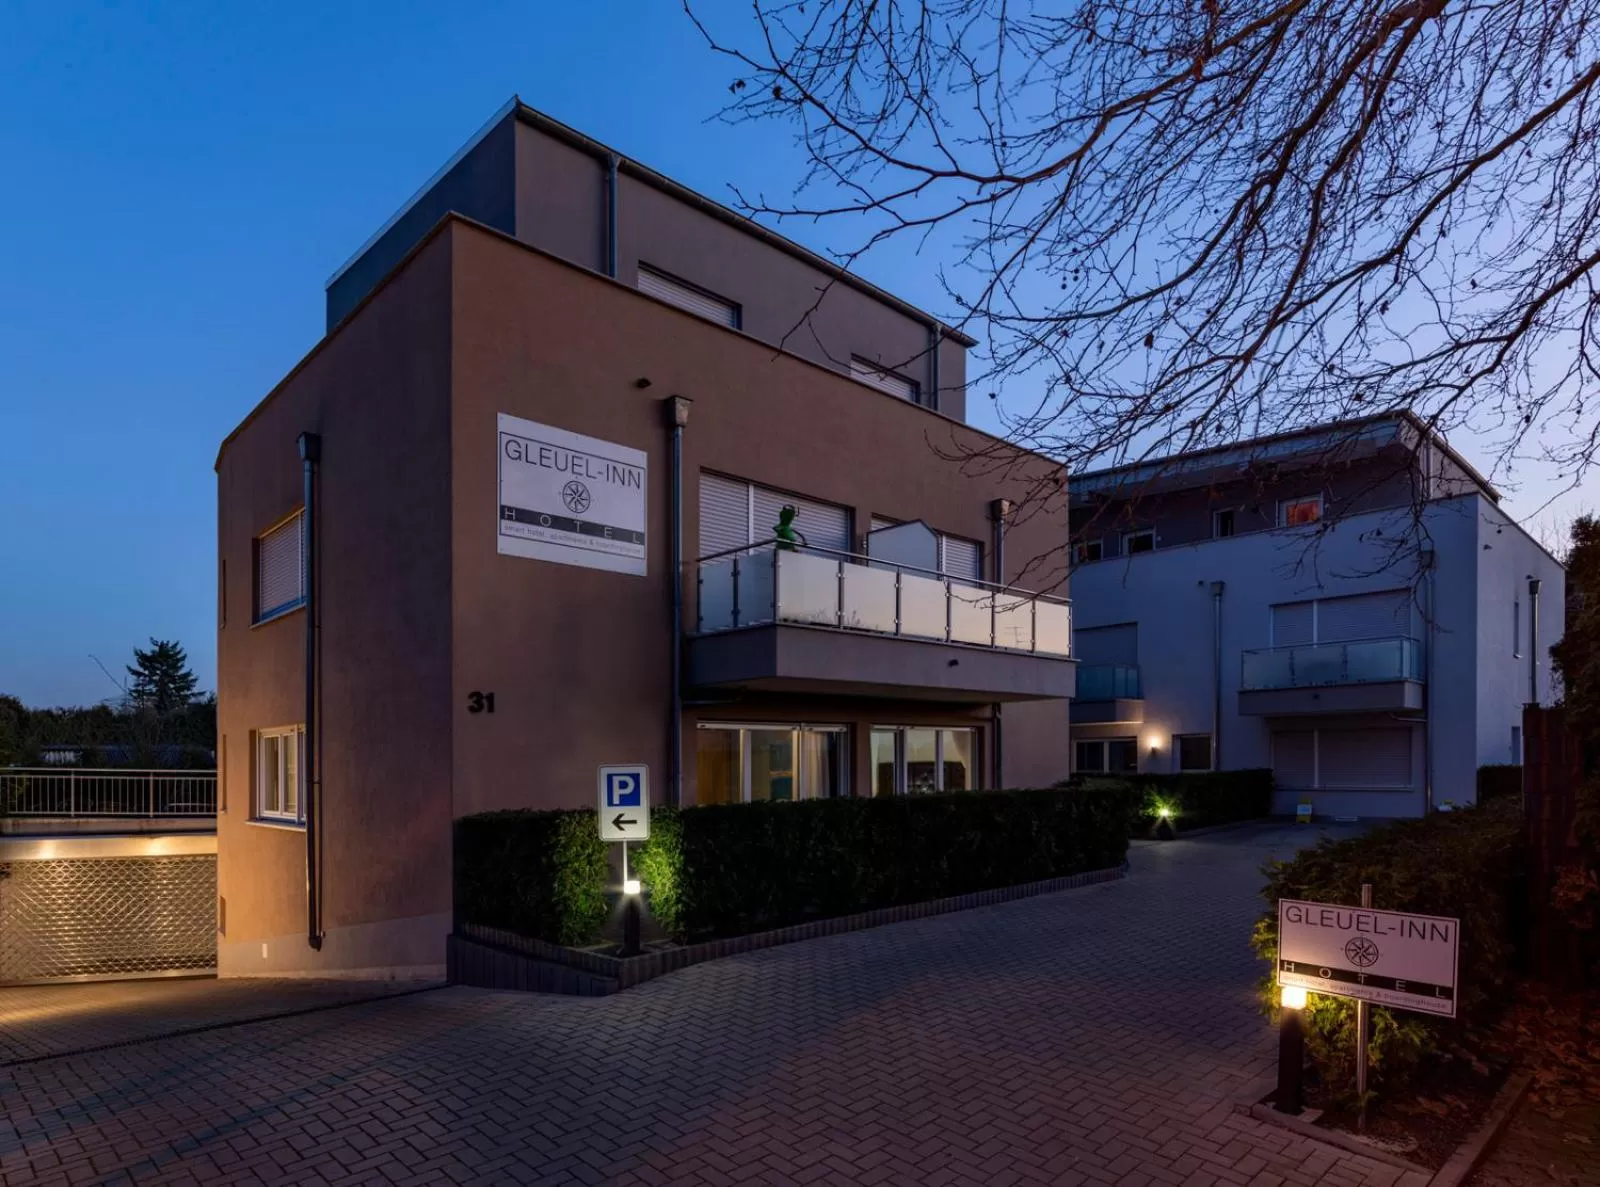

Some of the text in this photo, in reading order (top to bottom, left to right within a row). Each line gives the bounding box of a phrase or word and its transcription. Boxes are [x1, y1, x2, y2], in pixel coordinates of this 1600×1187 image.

[505, 439, 641, 490] GLEUEL-INN
[504, 507, 641, 544] HOTEL
[467, 691, 495, 714] 31
[612, 775, 635, 805] P
[1285, 905, 1449, 943] GLEUEL-INN
[1283, 962, 1446, 999] HOTEL
